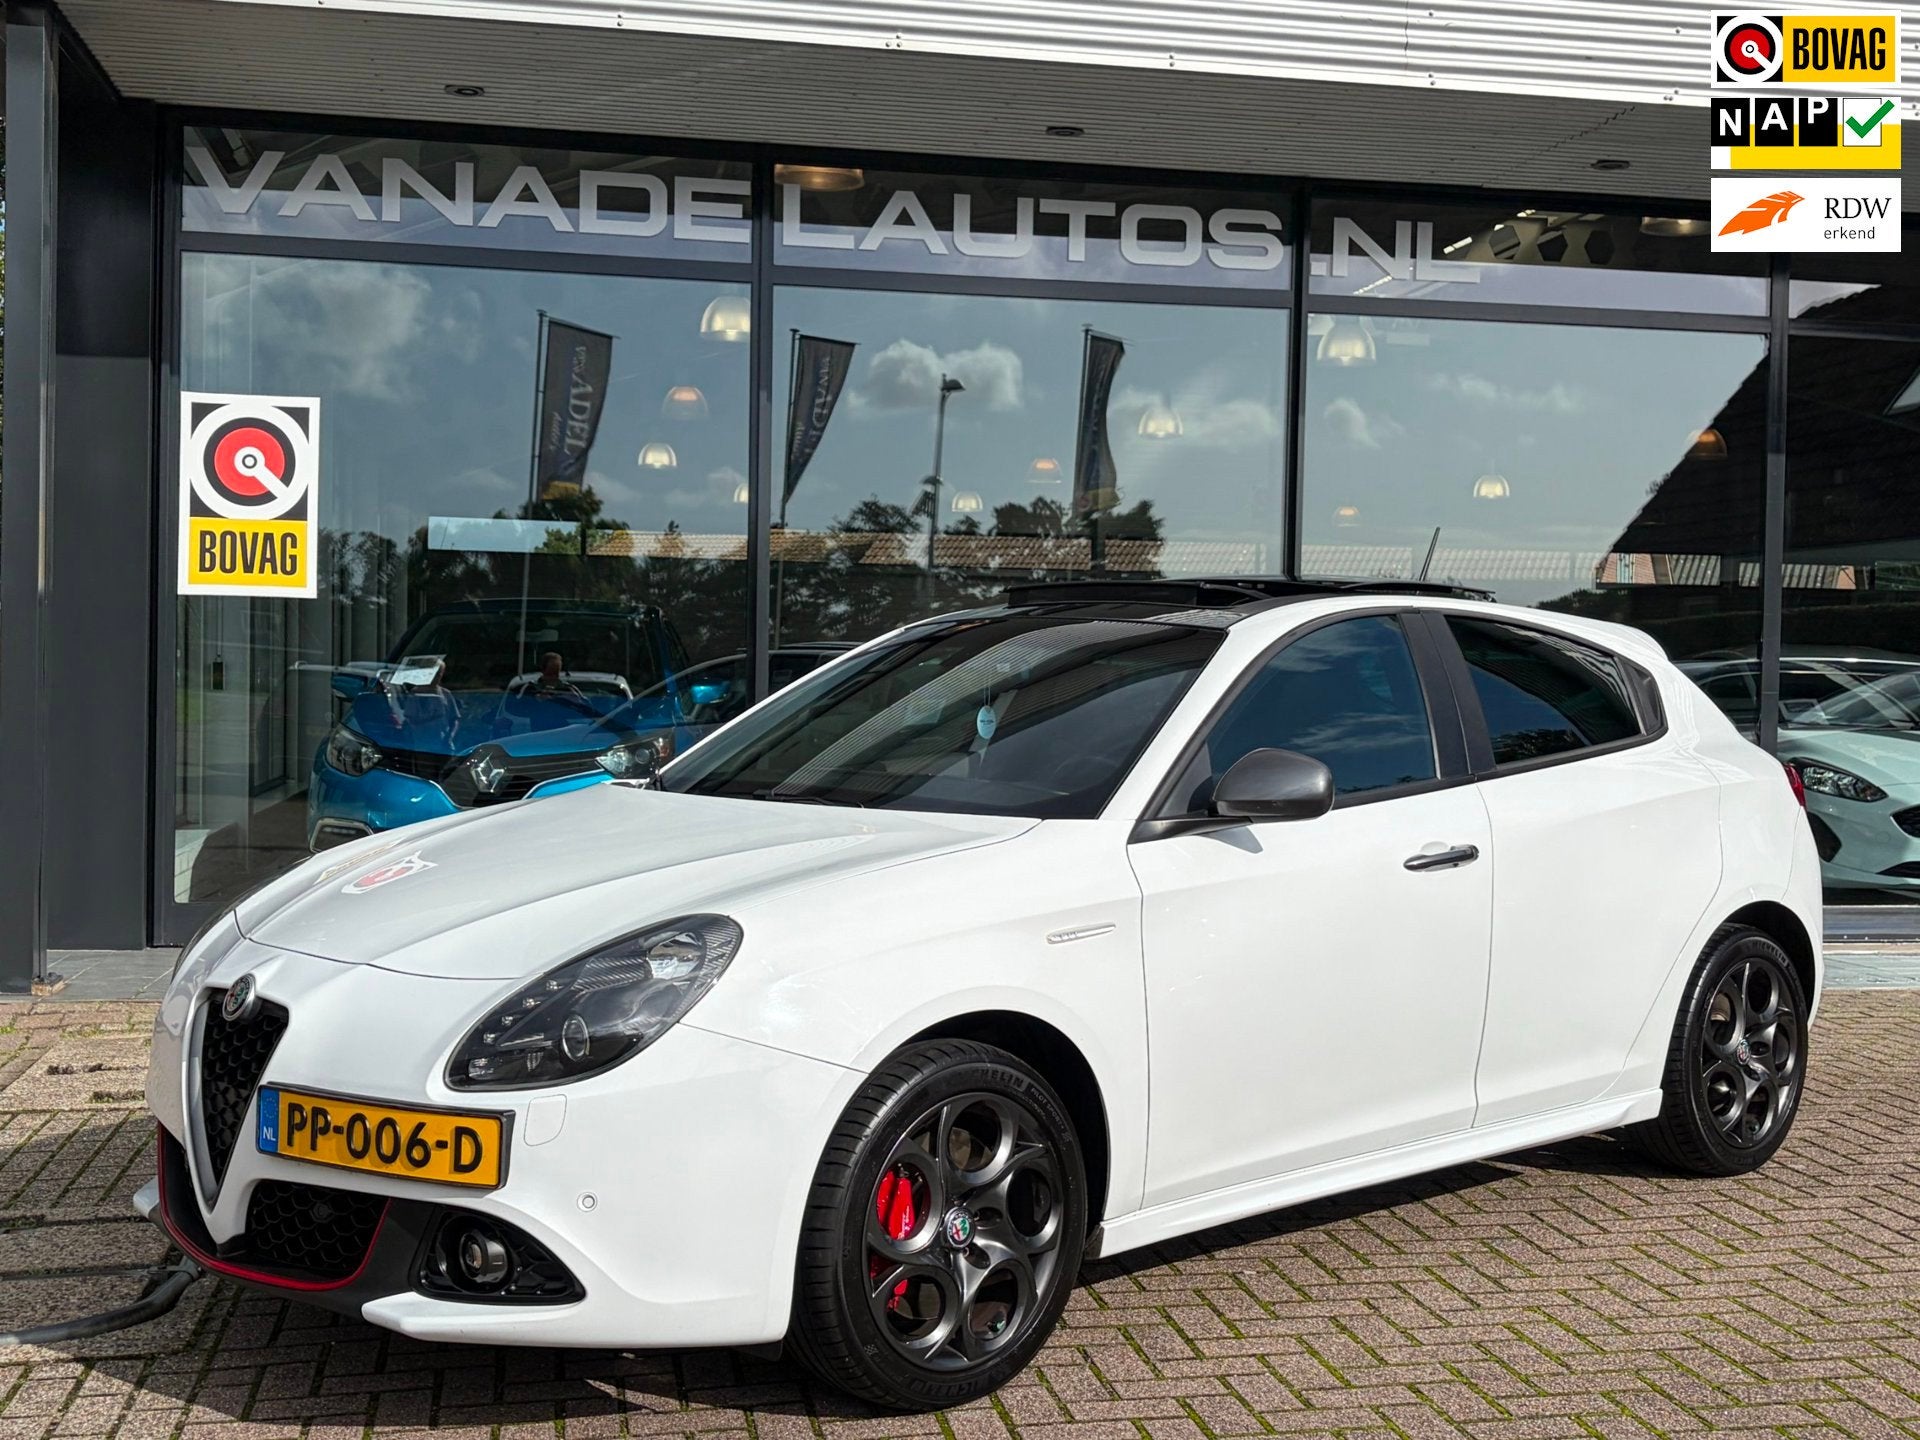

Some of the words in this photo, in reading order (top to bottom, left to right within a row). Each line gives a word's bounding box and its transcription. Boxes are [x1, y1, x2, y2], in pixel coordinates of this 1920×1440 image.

[198, 529, 298, 576] BOVAG
[263, 1126, 277, 1142] NL
[287, 1102, 483, 1173] PP-006-D
